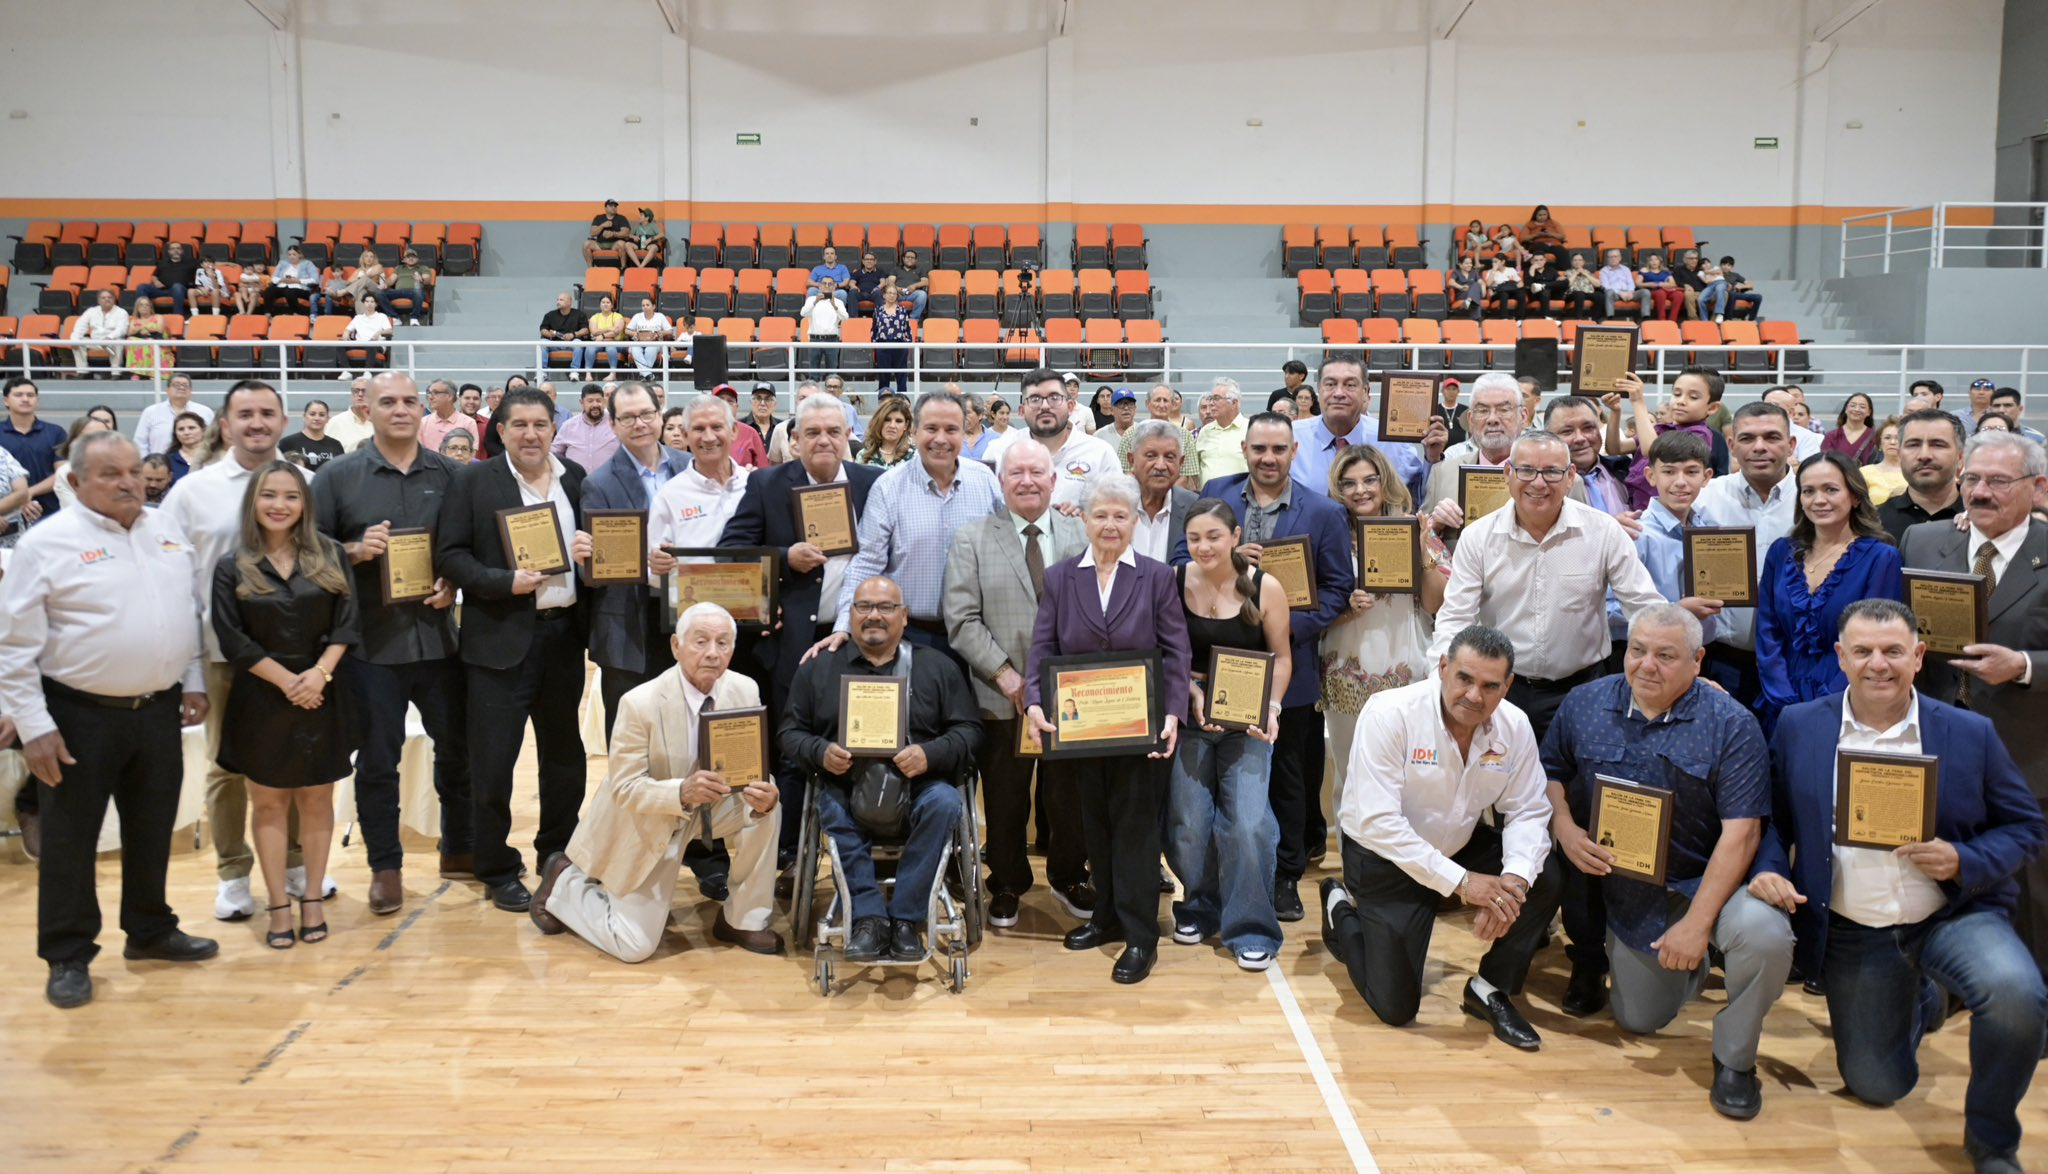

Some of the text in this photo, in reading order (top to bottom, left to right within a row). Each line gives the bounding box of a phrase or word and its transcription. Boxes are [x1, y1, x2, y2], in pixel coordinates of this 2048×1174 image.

[681, 505, 702, 518] IDH
[80, 547, 109, 564] IDH
[1071, 685, 1133, 698] Reconocimiento
[1413, 748, 1437, 760] IDH
[1900, 834, 1917, 842] IDH
[1636, 860, 1651, 870] IDH
